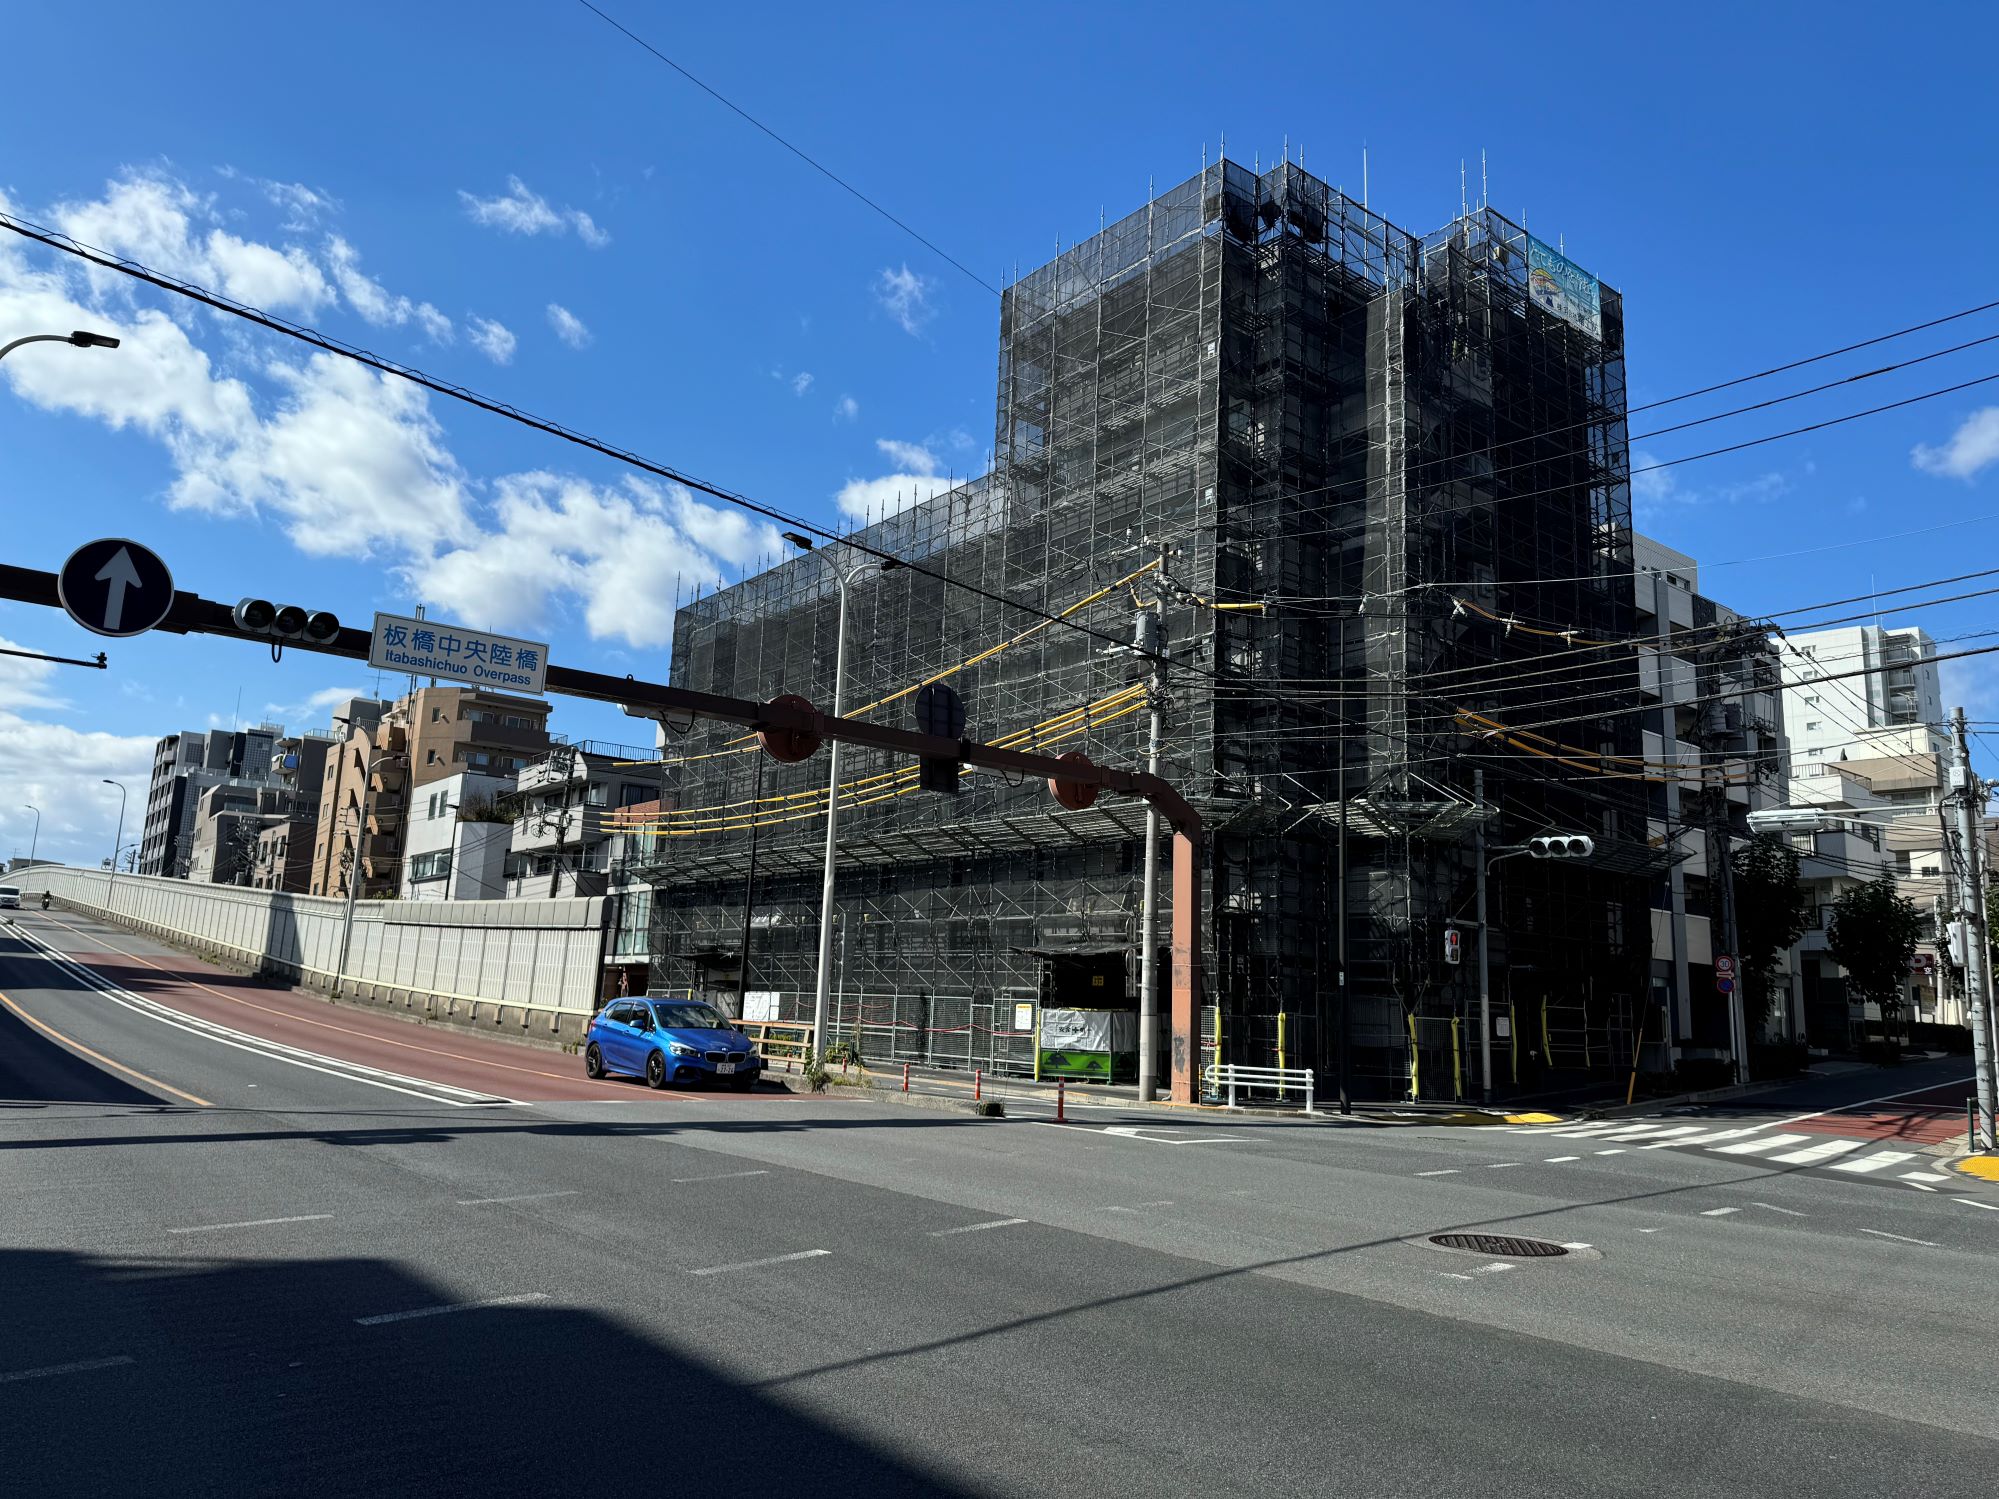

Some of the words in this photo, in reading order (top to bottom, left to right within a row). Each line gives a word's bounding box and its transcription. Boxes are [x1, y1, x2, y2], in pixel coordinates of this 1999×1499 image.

[383, 624, 538, 672] 板橋中央陸橋
[385, 649, 468, 674] Itabashichuo
[473, 665, 531, 685] Overpass
